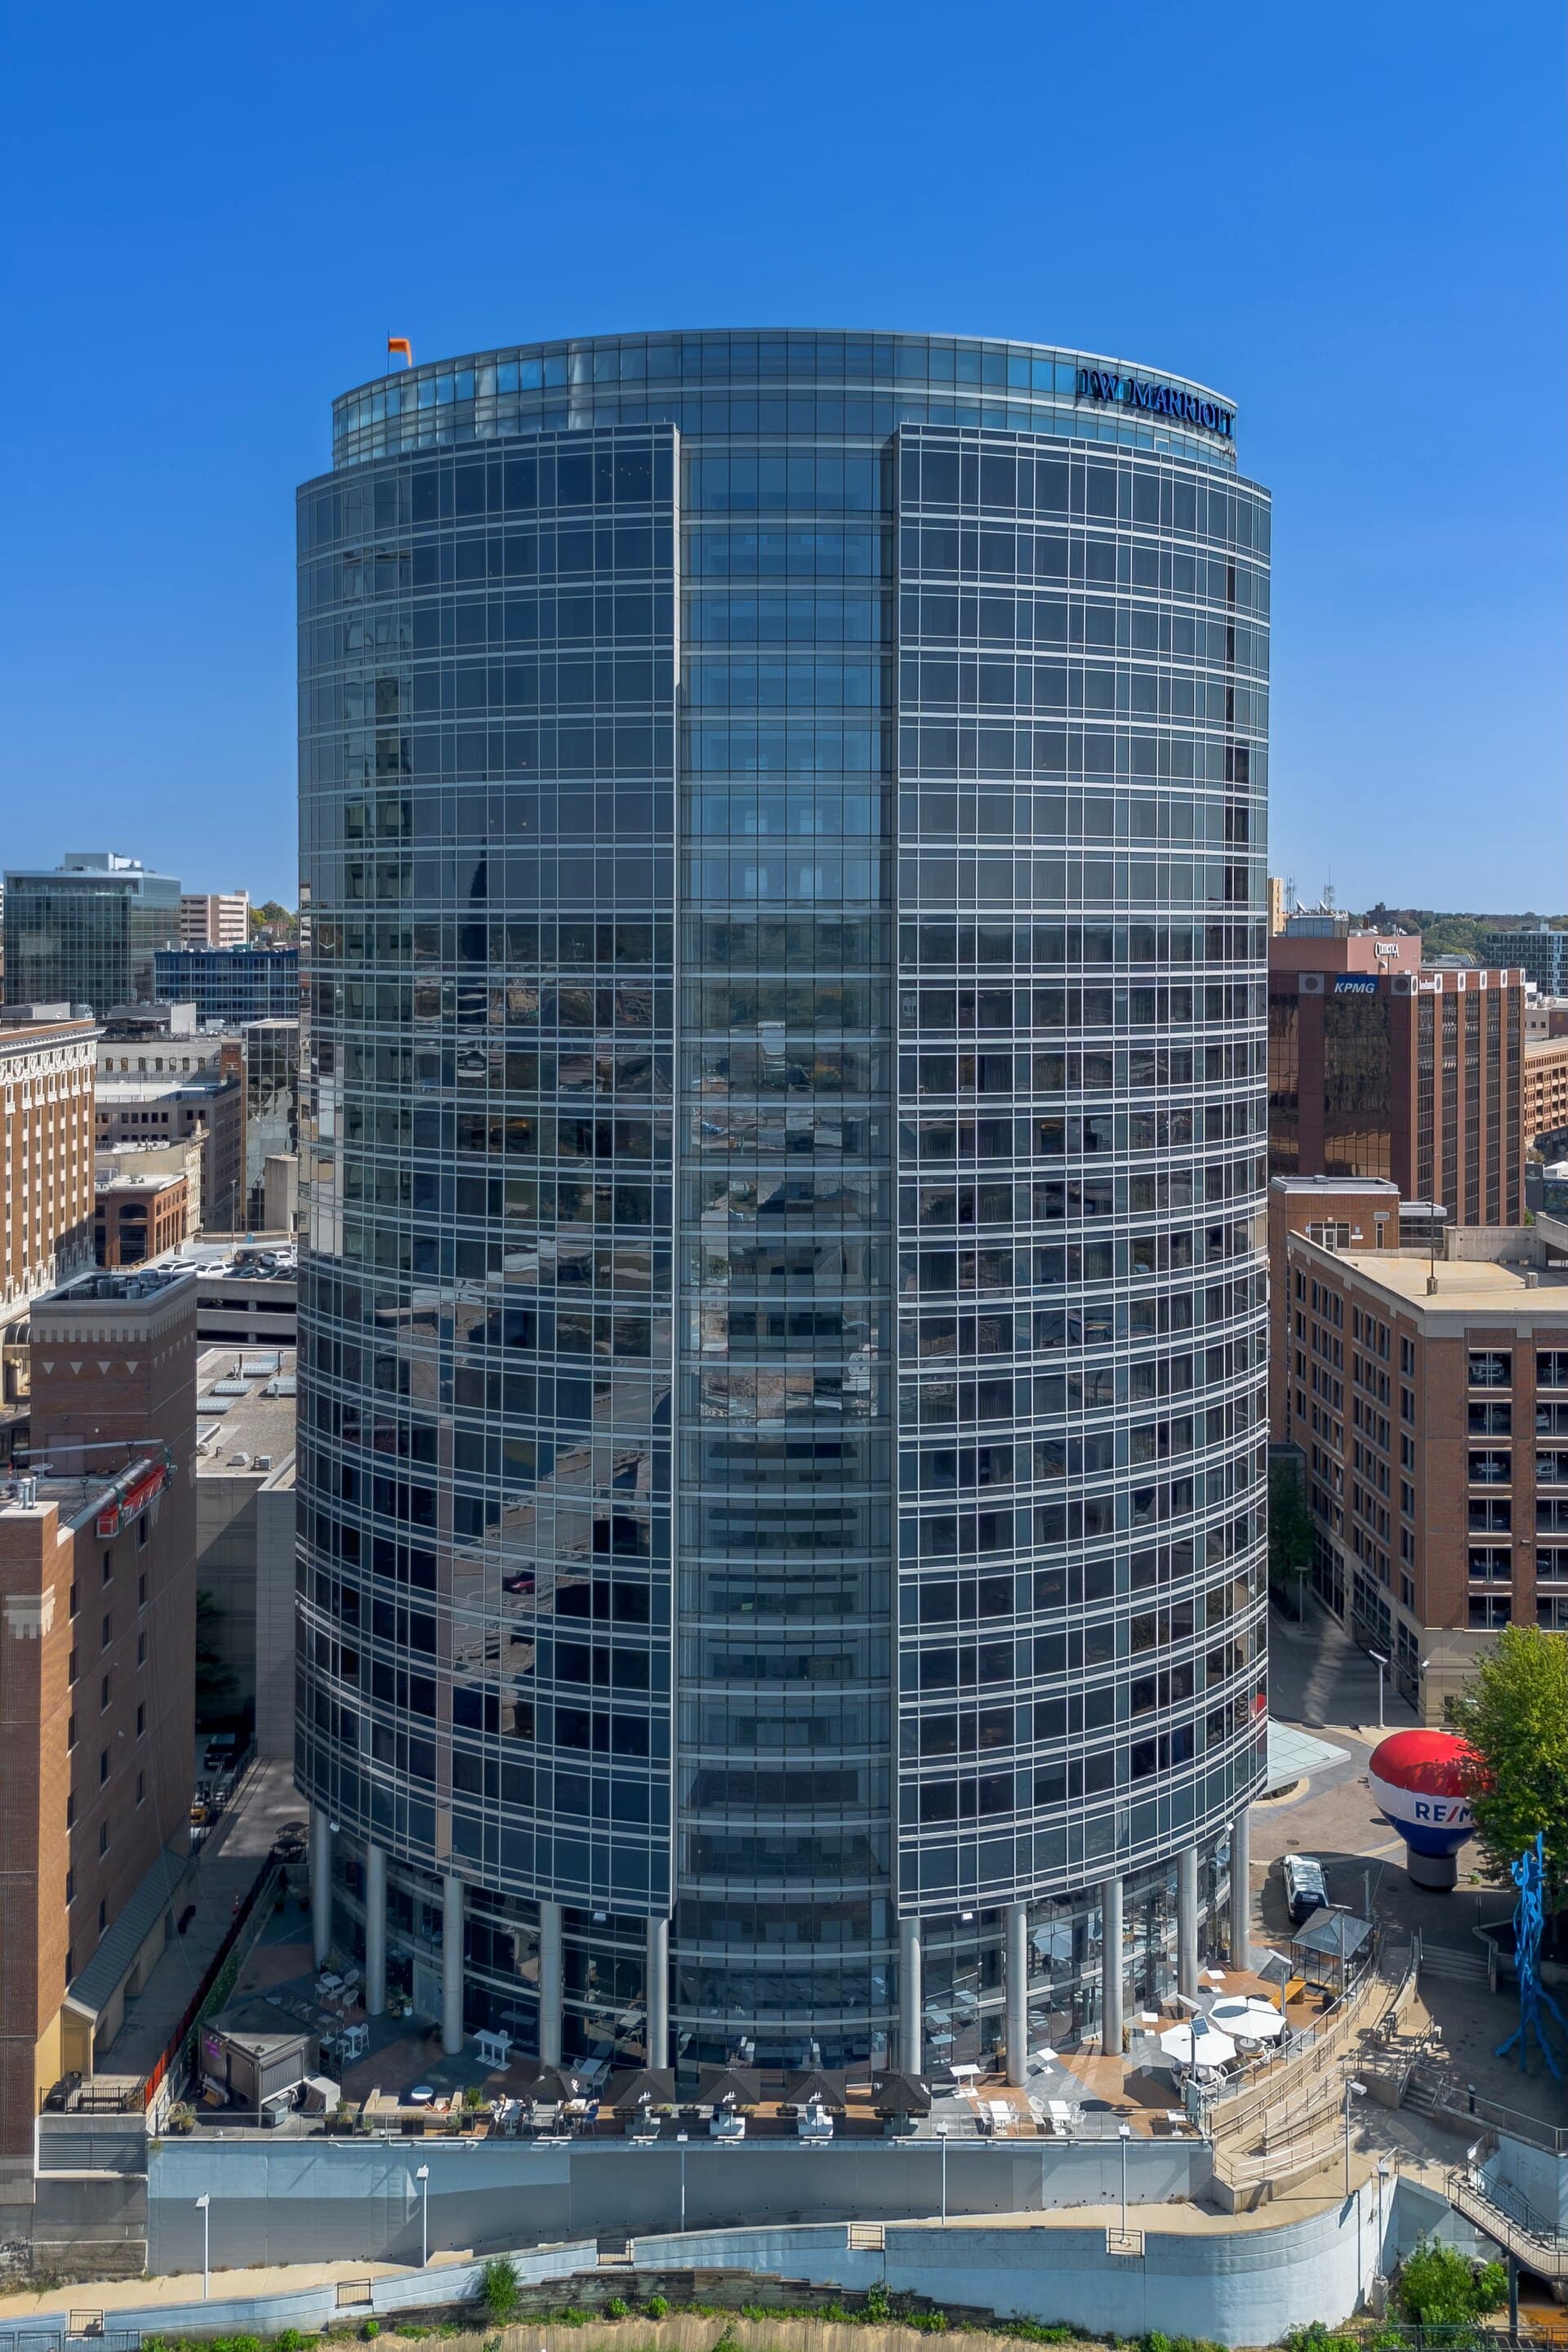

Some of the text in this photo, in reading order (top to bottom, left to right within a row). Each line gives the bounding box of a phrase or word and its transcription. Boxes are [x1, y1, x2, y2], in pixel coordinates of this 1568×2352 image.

[1078, 368, 1235, 438] JW MARRIOTT
[1334, 982, 1375, 993] KPMG
